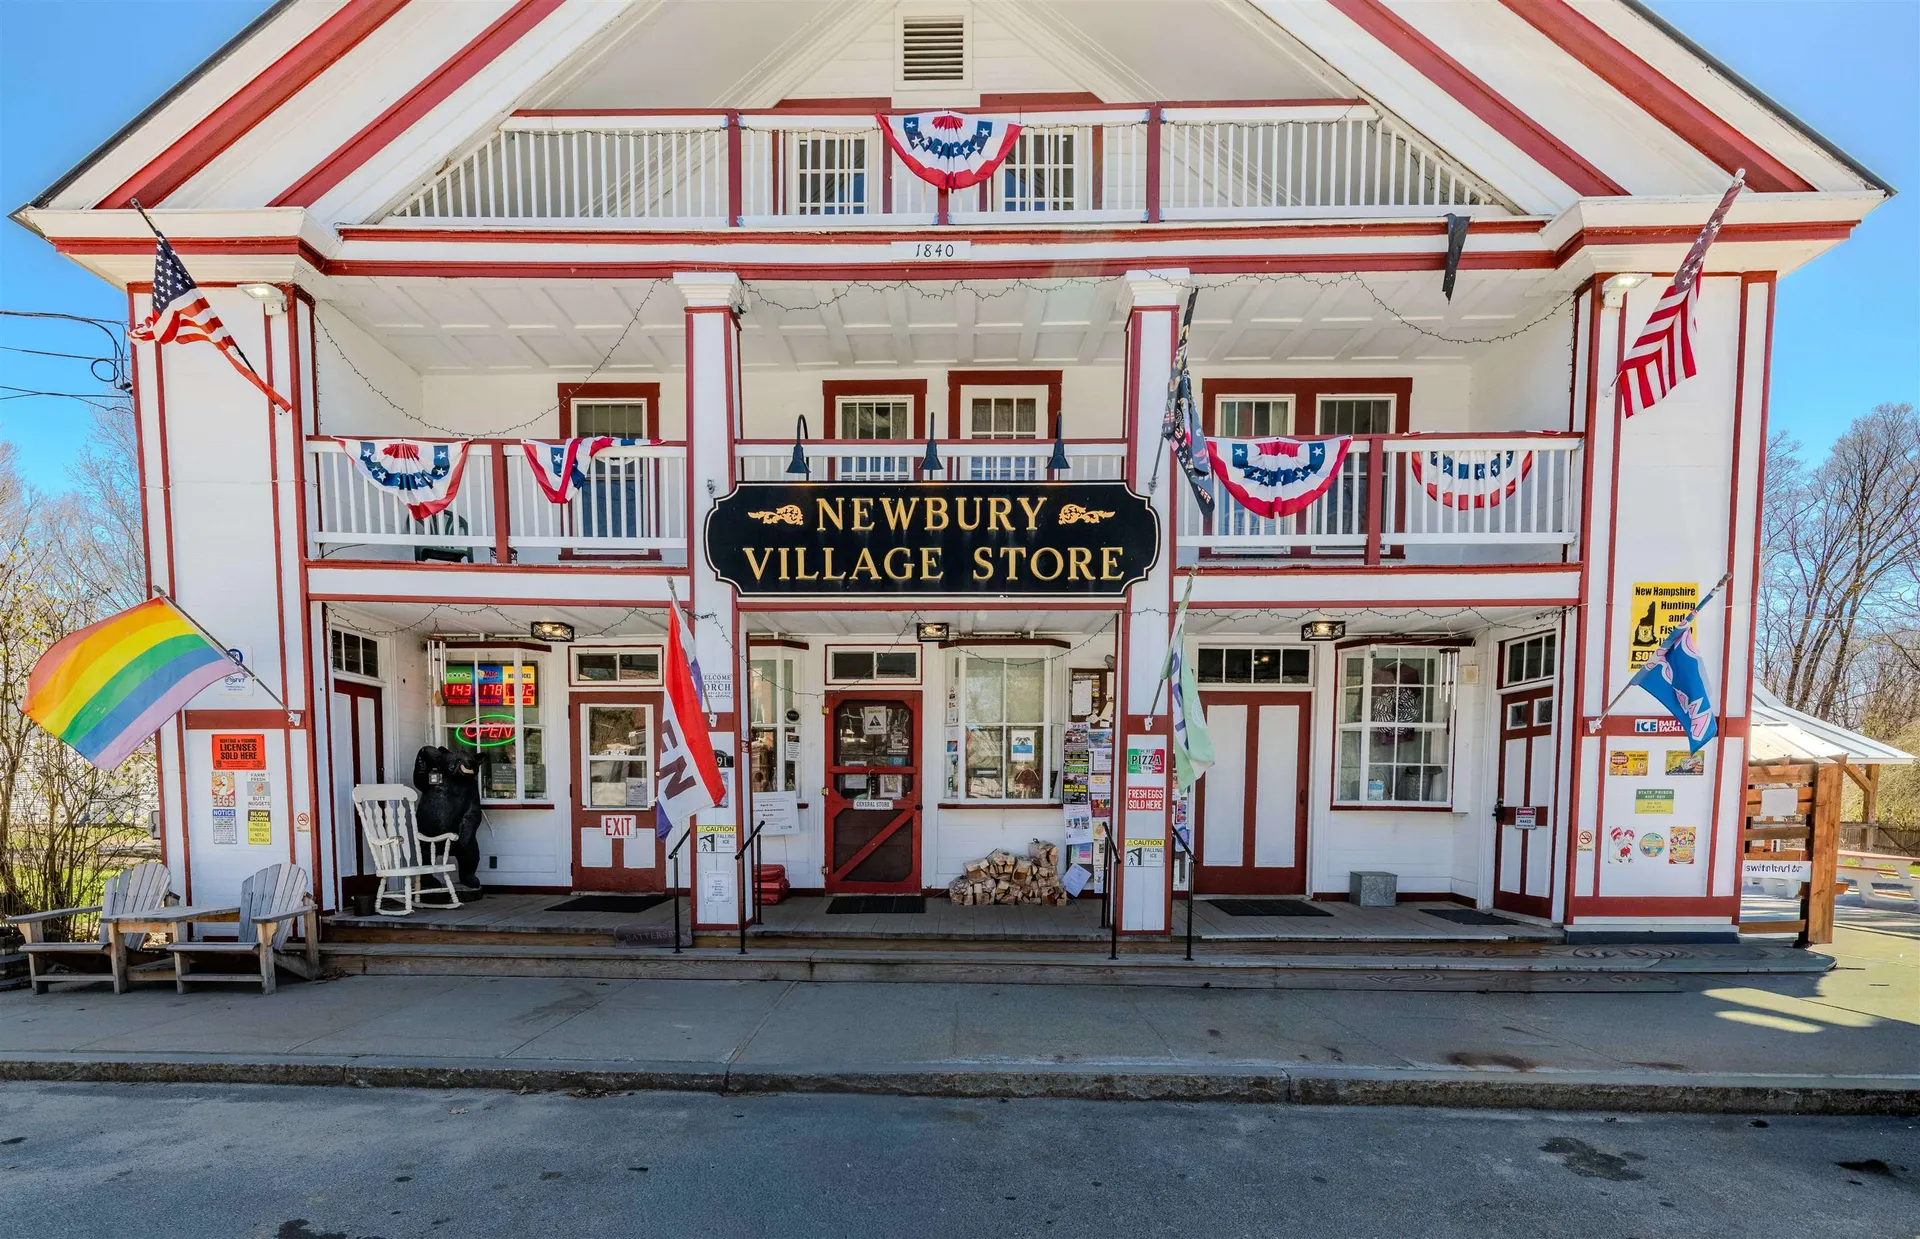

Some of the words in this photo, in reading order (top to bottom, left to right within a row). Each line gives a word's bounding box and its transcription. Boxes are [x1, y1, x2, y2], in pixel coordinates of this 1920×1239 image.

[915, 243, 954, 258] 1840
[816, 497, 1047, 531] NEWBURY
[743, 547, 945, 581] VILLAGE
[972, 547, 1125, 581] STORE
[1635, 587, 1652, 596] New
[1653, 587, 1696, 597] Hampshire
[1661, 601, 1696, 611] Hunting
[1668, 614, 1685, 622] and
[1635, 651, 1653, 661] SO
[452, 684, 472, 696] 143
[483, 684, 502, 696] 178
[704, 683, 731, 691] ORCH
[464, 721, 513, 738] OPEN
[1636, 721, 1656, 732] ICE
[220, 743, 257, 752] LICENSES
[220, 752, 238, 760] SOLD
[240, 752, 257, 760] HERE
[660, 719, 697, 800] EN
[1131, 755, 1161, 765] PIZZA
[1128, 789, 1147, 799] FRESH
[1148, 789, 1163, 799] EGGS
[1128, 800, 1146, 809] SOLD
[1146, 800, 1163, 809] HERE
[605, 817, 632, 836] EXIT
[625, 930, 677, 942] BATTERSB
